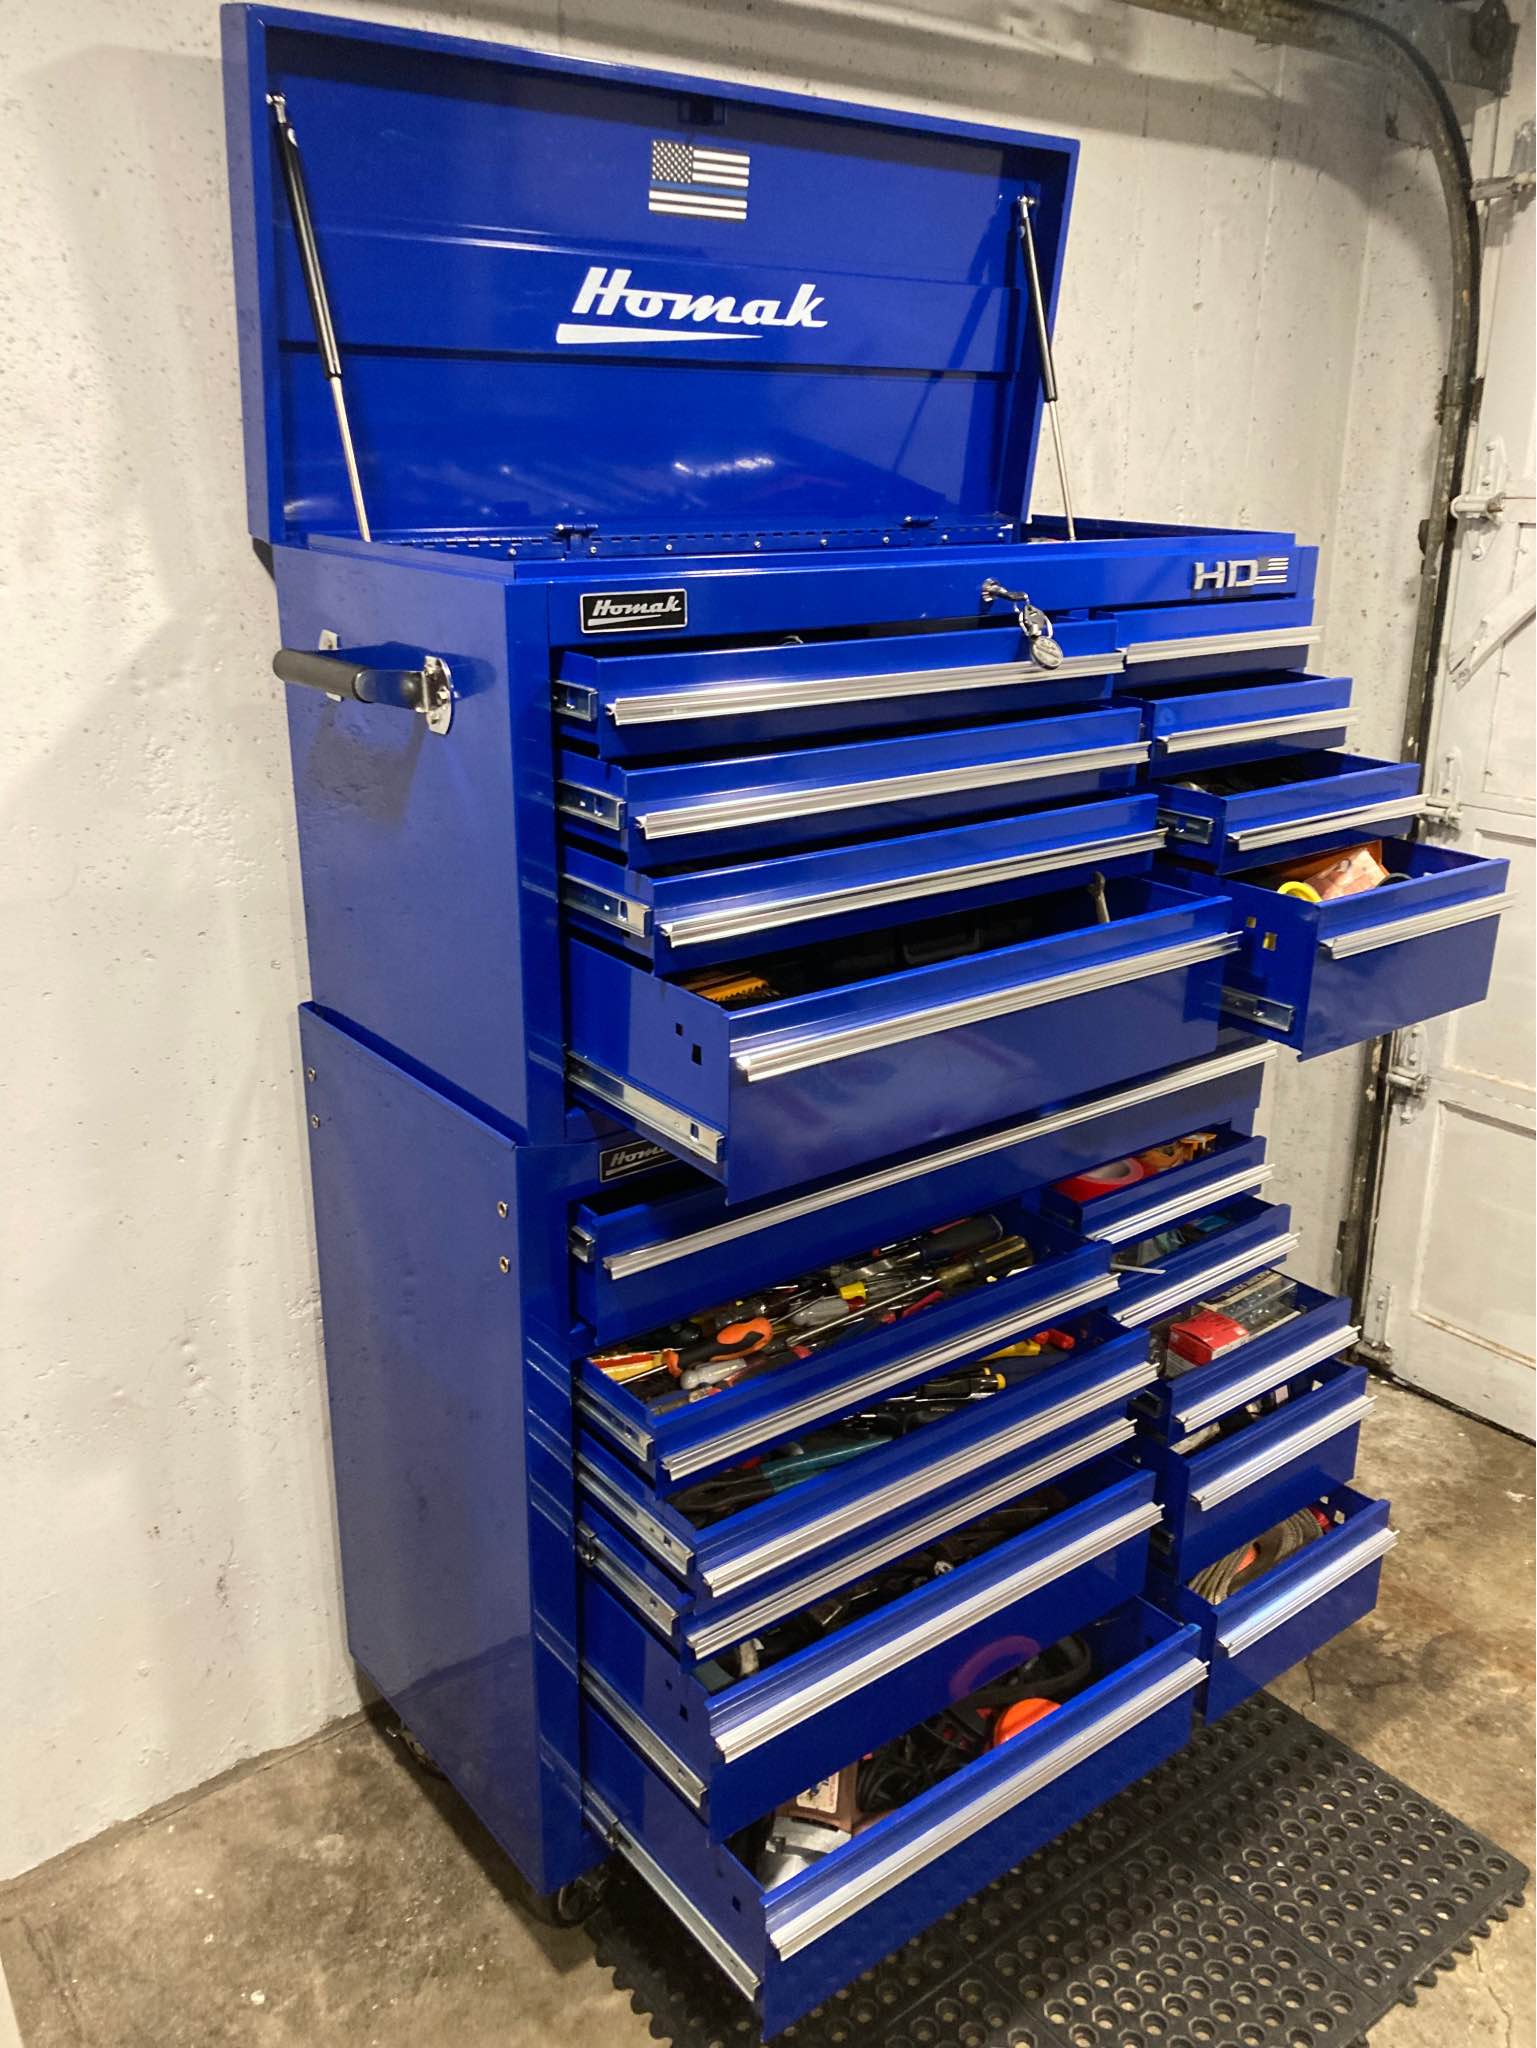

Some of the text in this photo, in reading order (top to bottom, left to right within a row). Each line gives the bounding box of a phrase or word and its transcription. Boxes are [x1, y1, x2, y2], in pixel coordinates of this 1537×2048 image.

[571, 266, 828, 328] Homak
[1194, 560, 1258, 589] HD
[592, 595, 682, 617] Homak
